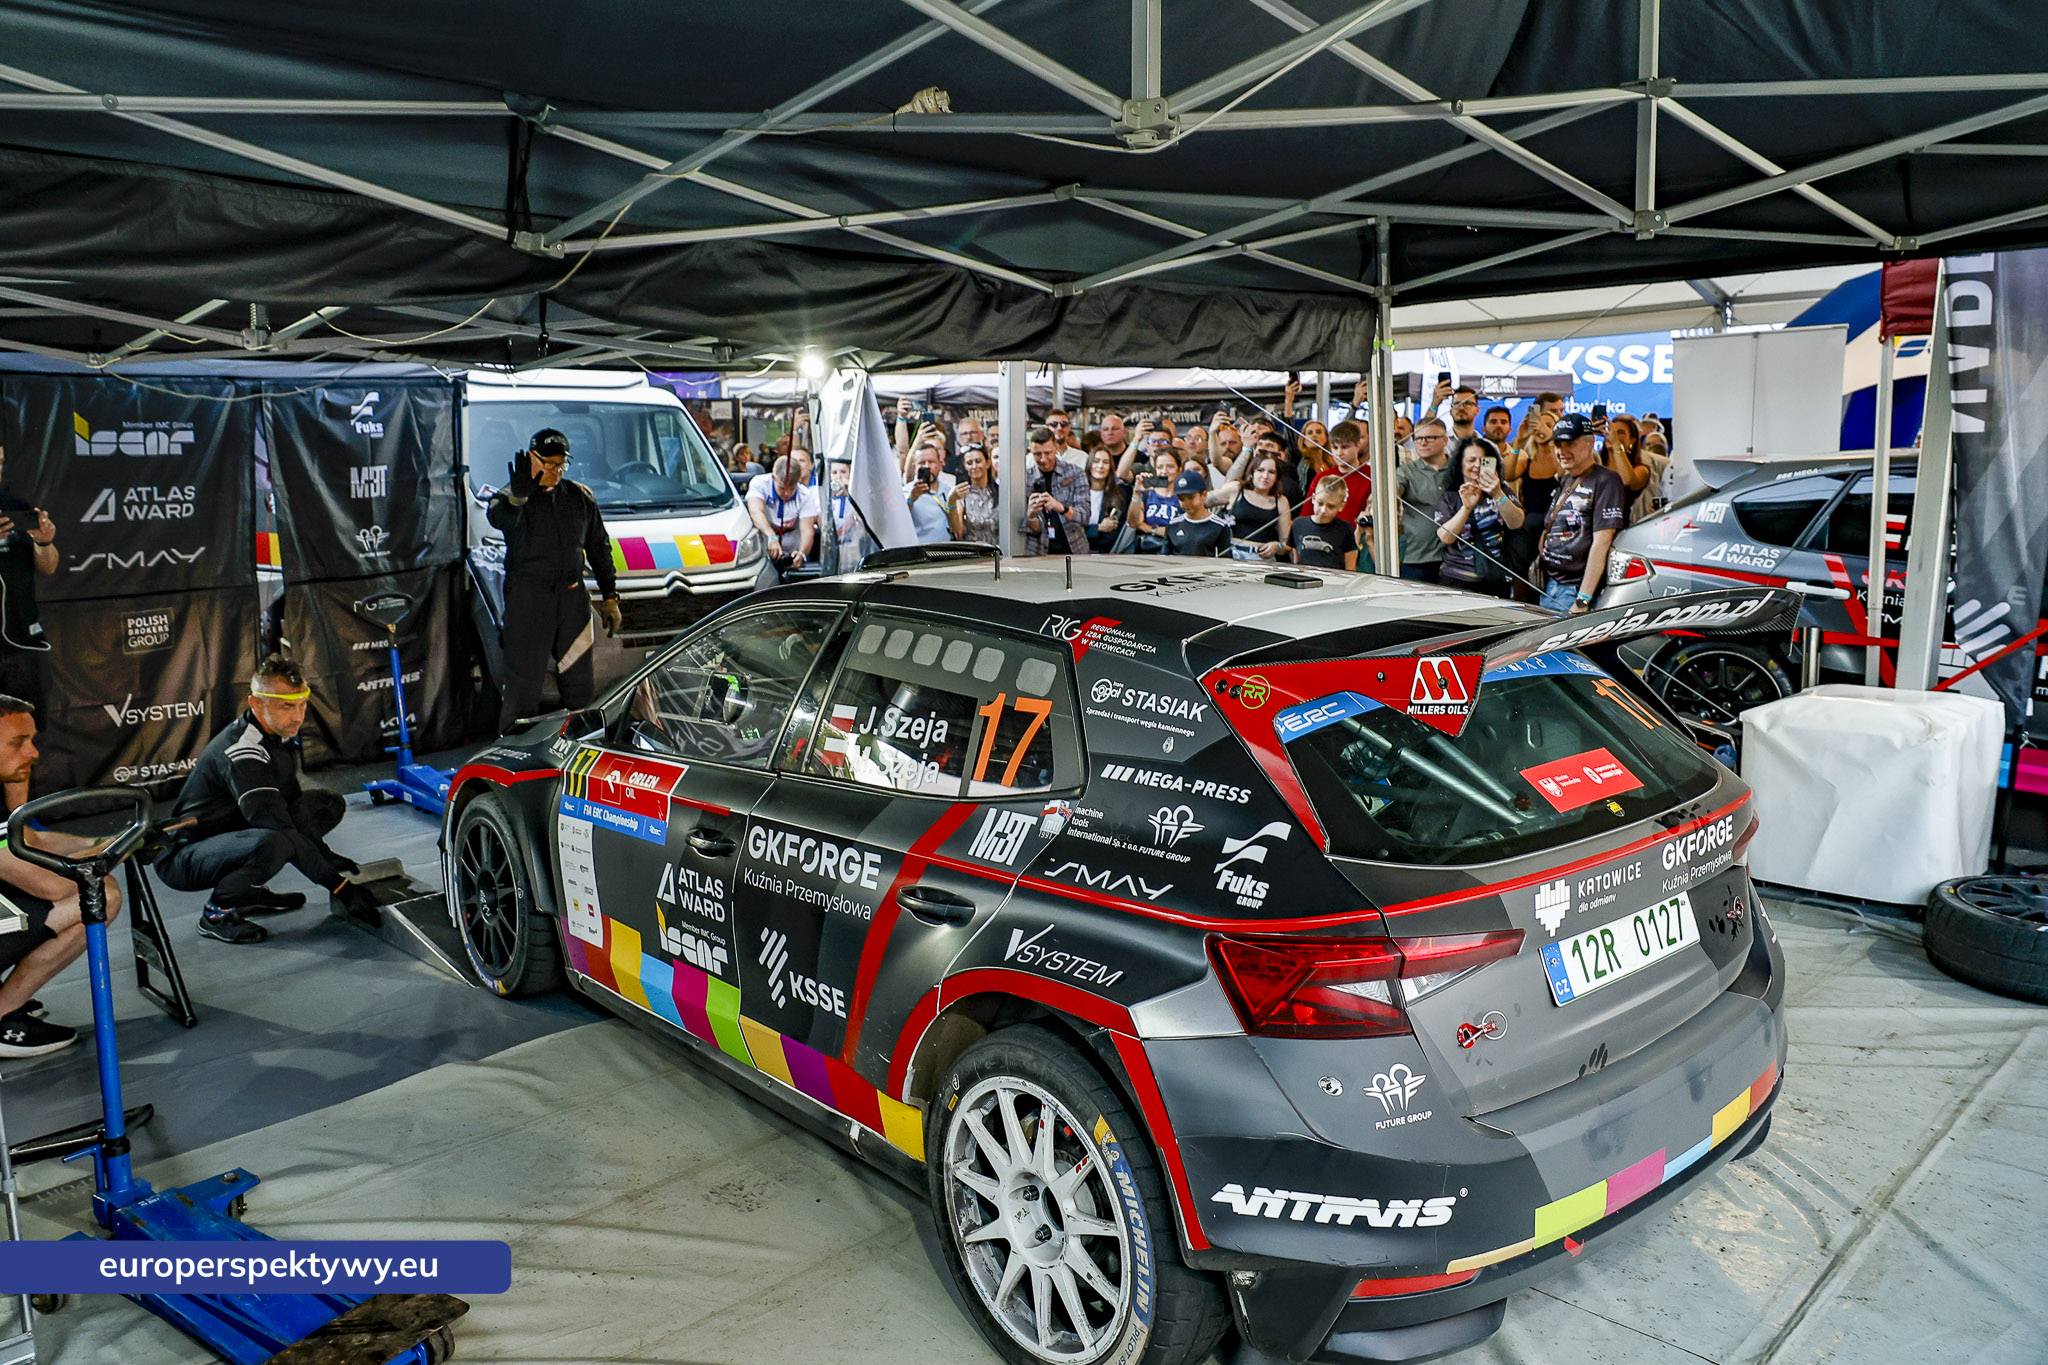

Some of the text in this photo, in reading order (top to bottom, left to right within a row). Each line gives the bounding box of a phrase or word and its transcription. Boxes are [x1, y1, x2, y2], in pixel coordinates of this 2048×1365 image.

[1548, 344, 1673, 384] KSSE
[355, 421, 384, 434] Fuks
[123, 485, 196, 503] ATLAS
[350, 465, 388, 499] MBT
[123, 503, 195, 521] WARD
[1726, 554, 1776, 569] WARD
[1728, 543, 1781, 559] ATLAS
[127, 614, 169, 628] POLISH
[128, 624, 170, 636] BROKERS
[1090, 623, 1136, 640] REGIONALNA
[128, 633, 170, 648] GROUP
[1084, 630, 1157, 654] IZBA GOSPODARCZA
[1089, 639, 1137, 658] KATOWICACH
[1122, 688, 1208, 723] STASIAK
[1406, 705, 1469, 715] MILLERS OILS
[1086, 706, 1111, 720] Sprzedaż
[1114, 712, 1140, 725] transport
[1140, 719, 1158, 729] węgla
[1157, 722, 1196, 737] kamiennego
[972, 692, 1053, 788] 17
[569, 748, 600, 798] 17
[628, 771, 660, 790] ORLEN
[625, 787, 637, 800] OIL
[1134, 769, 1252, 804] MEGA-PRESS
[583, 804, 592, 816] FIA
[593, 807, 603, 819] ERC
[603, 810, 640, 832] Championship
[1071, 816, 1090, 828] tools
[1075, 806, 1104, 820] machine
[967, 807, 1039, 867] MBT
[1067, 827, 1113, 845] international
[1112, 838, 1122, 848] Sp.
[1662, 815, 1733, 871] GKFORGE
[749, 825, 882, 891] GKFORGE
[1138, 846, 1191, 864] FUTURE GROUP
[678, 867, 724, 900] ATLAS
[1044, 861, 1174, 900] SMAY
[1578, 861, 1643, 898] KATOWICE
[1662, 850, 1732, 894] Kuźnia Przemysłowa
[744, 867, 873, 921] Kuźnia Przemysłowa
[1216, 870, 1270, 900] Fuks
[678, 889, 726, 923] WARD
[1236, 896, 1263, 910] GROUP
[1578, 893, 1617, 913] dla odmiany
[710, 932, 726, 947] Group
[1572, 897, 1684, 984] 12R 0127
[789, 970, 847, 1019] KSSE
[1555, 978, 1571, 996] CZ
[1375, 1110, 1433, 1131] FUTURE GROUP
[1115, 1171, 1150, 1314] MICHELIN
[1123, 1325, 1142, 1356] PILOT
